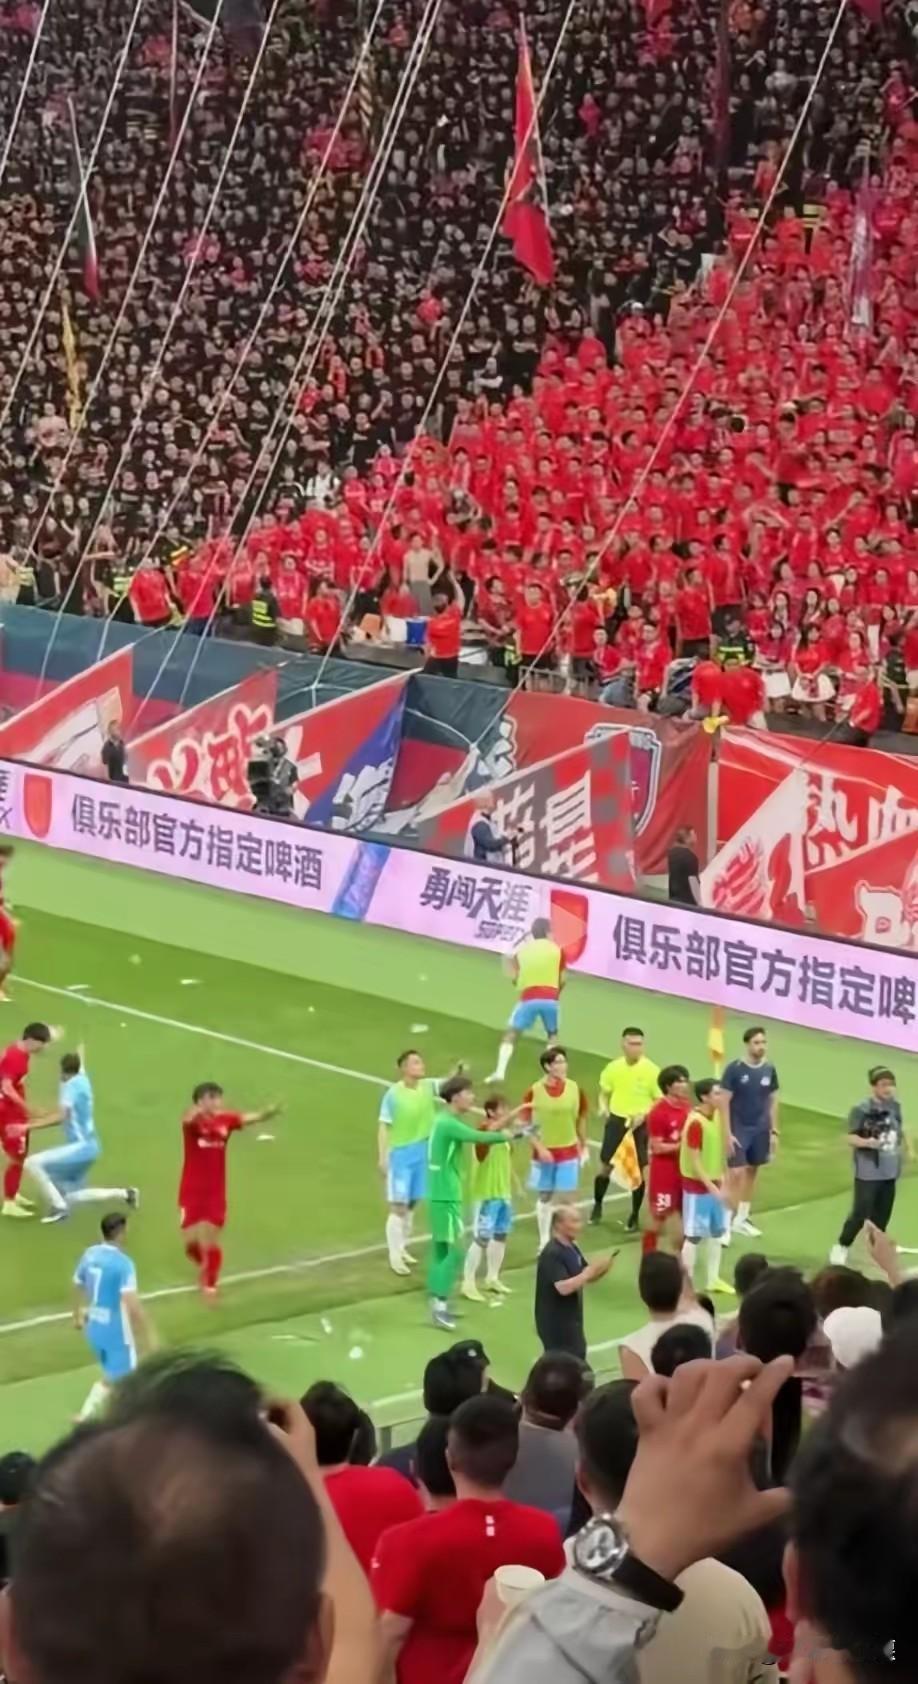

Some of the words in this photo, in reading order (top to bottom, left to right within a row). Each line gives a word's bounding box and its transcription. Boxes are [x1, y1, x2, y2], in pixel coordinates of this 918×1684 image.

[72, 794, 322, 890] 俱乐部官方指定啤酒
[420, 866, 532, 921] 勇闯天涯
[613, 914, 917, 1025] 俱乐部官方指定啤
